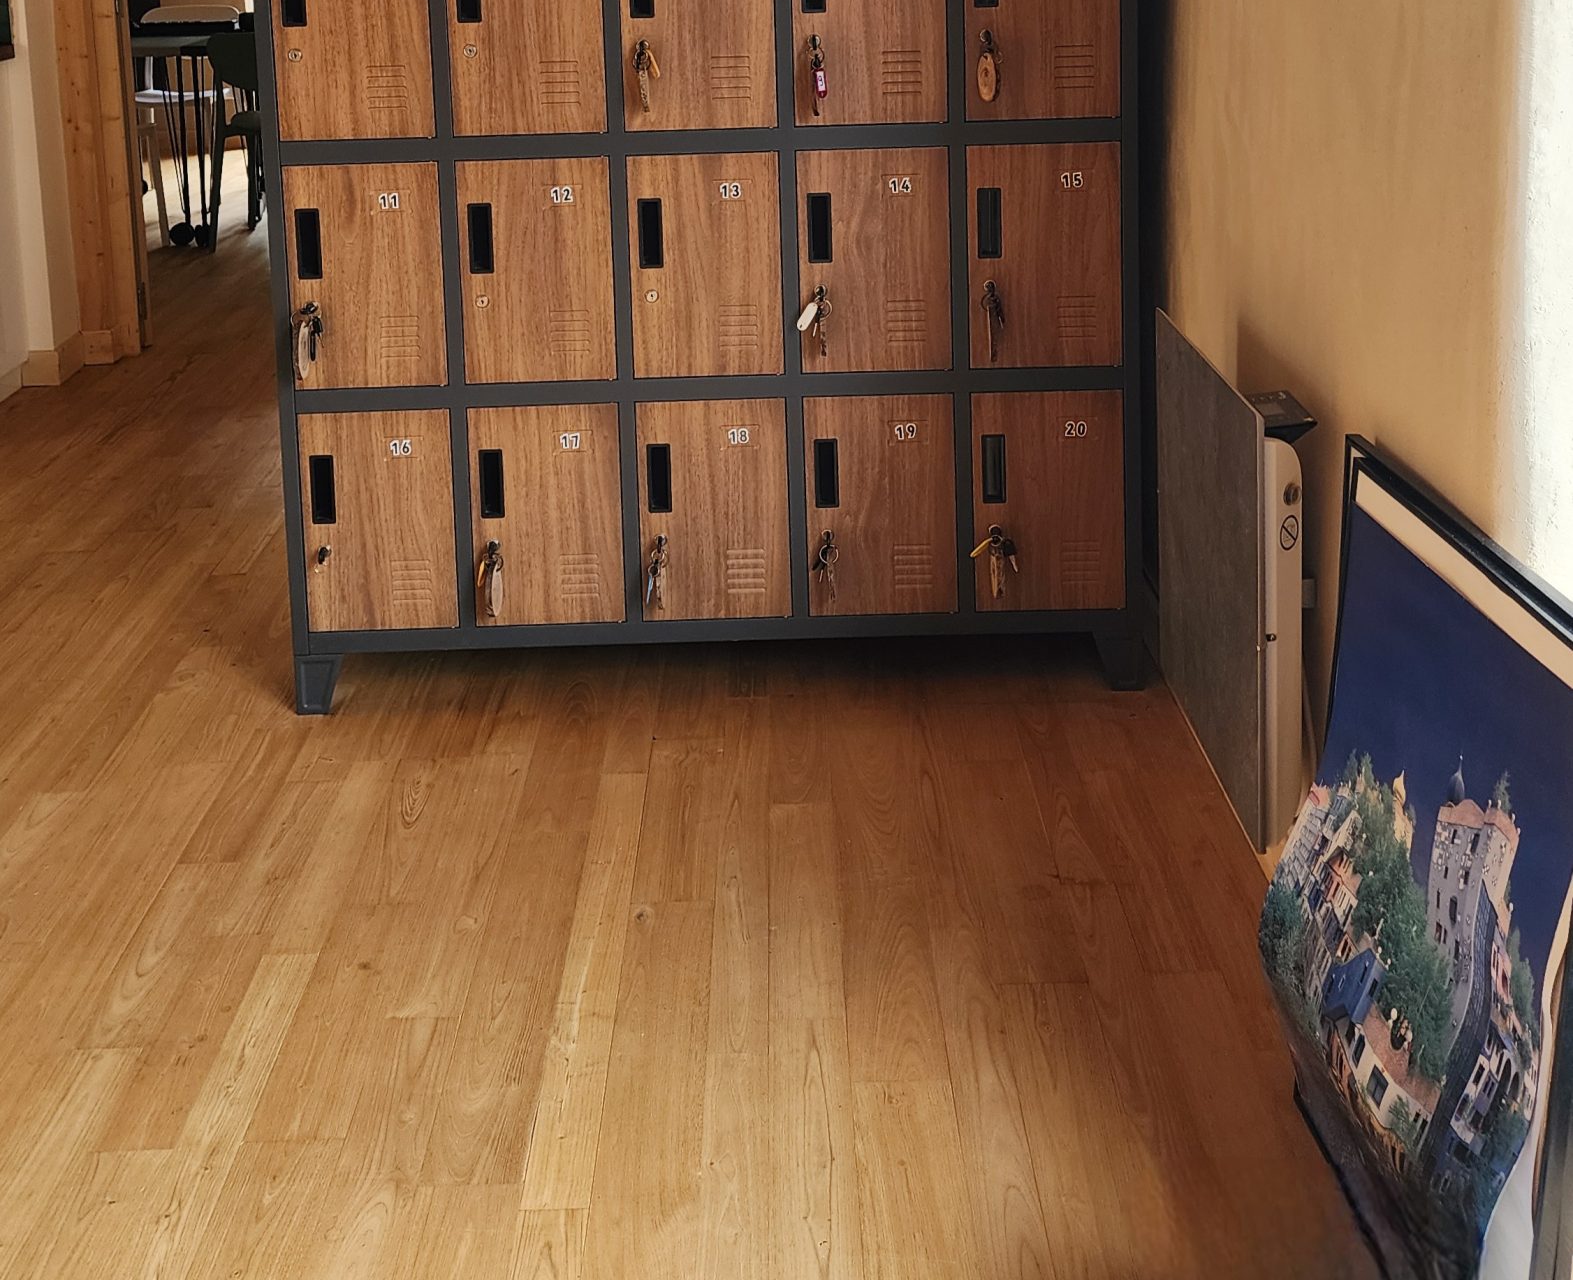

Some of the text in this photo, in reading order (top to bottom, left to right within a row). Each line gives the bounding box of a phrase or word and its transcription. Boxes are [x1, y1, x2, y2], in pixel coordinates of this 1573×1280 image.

[889, 178, 911, 193] 14
[1061, 172, 1083, 188] 15
[551, 188, 573, 203] 12
[720, 183, 740, 198] 13
[379, 193, 398, 209] 11
[728, 429, 749, 444] 18
[895, 423, 916, 440] 19
[1065, 422, 1087, 437] 20
[390, 439, 411, 455] 16
[560, 433, 580, 449] 17
